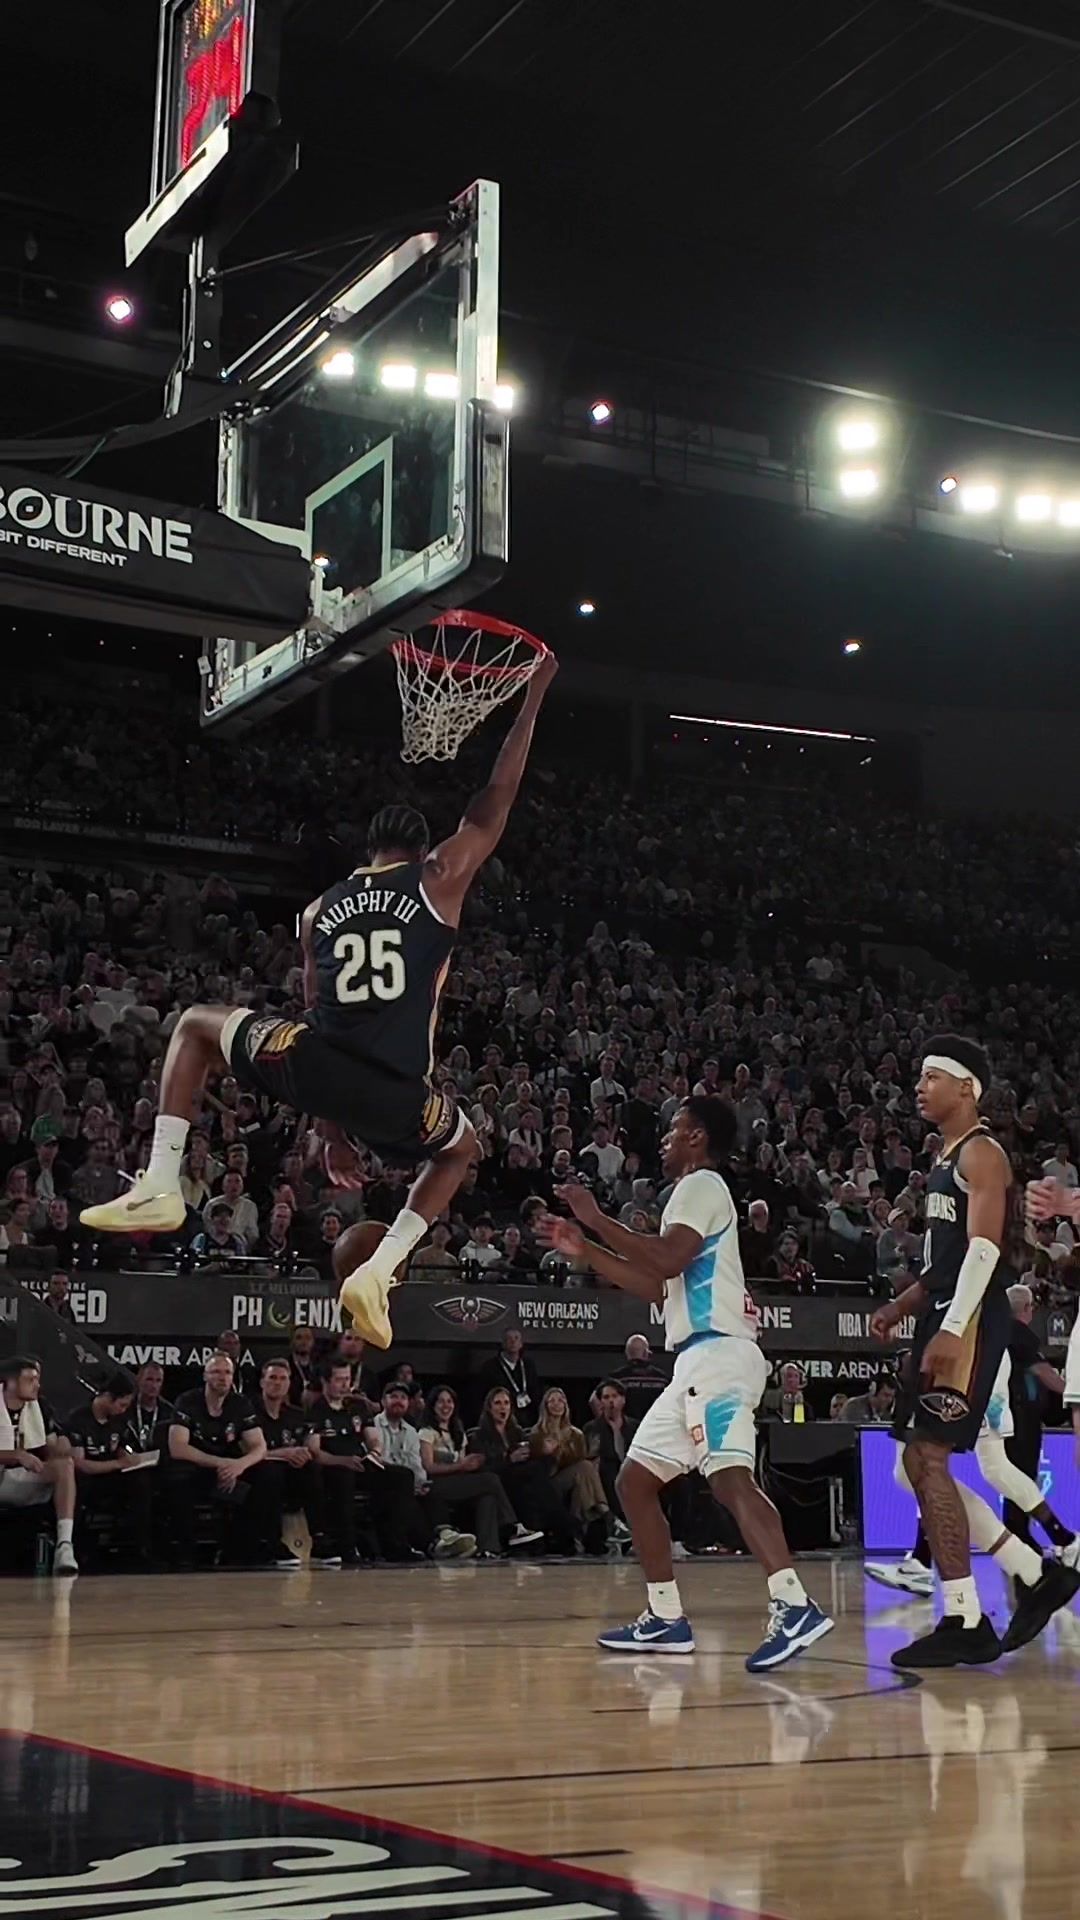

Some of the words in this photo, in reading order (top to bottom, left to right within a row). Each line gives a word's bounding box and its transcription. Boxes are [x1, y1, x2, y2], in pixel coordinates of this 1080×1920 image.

[27, 535, 127, 567] DIFFERENT
[316, 890, 396, 936] MURPHY
[393, 894, 421, 924] III
[333, 929, 406, 1004] 25
[518, 1301, 546, 1318] NEW
[548, 1302, 599, 1320] ORLEANS
[523, 1320, 594, 1329] PELICANS
[838, 1313, 862, 1337] NBA
[107, 1345, 181, 1365] LAVER
